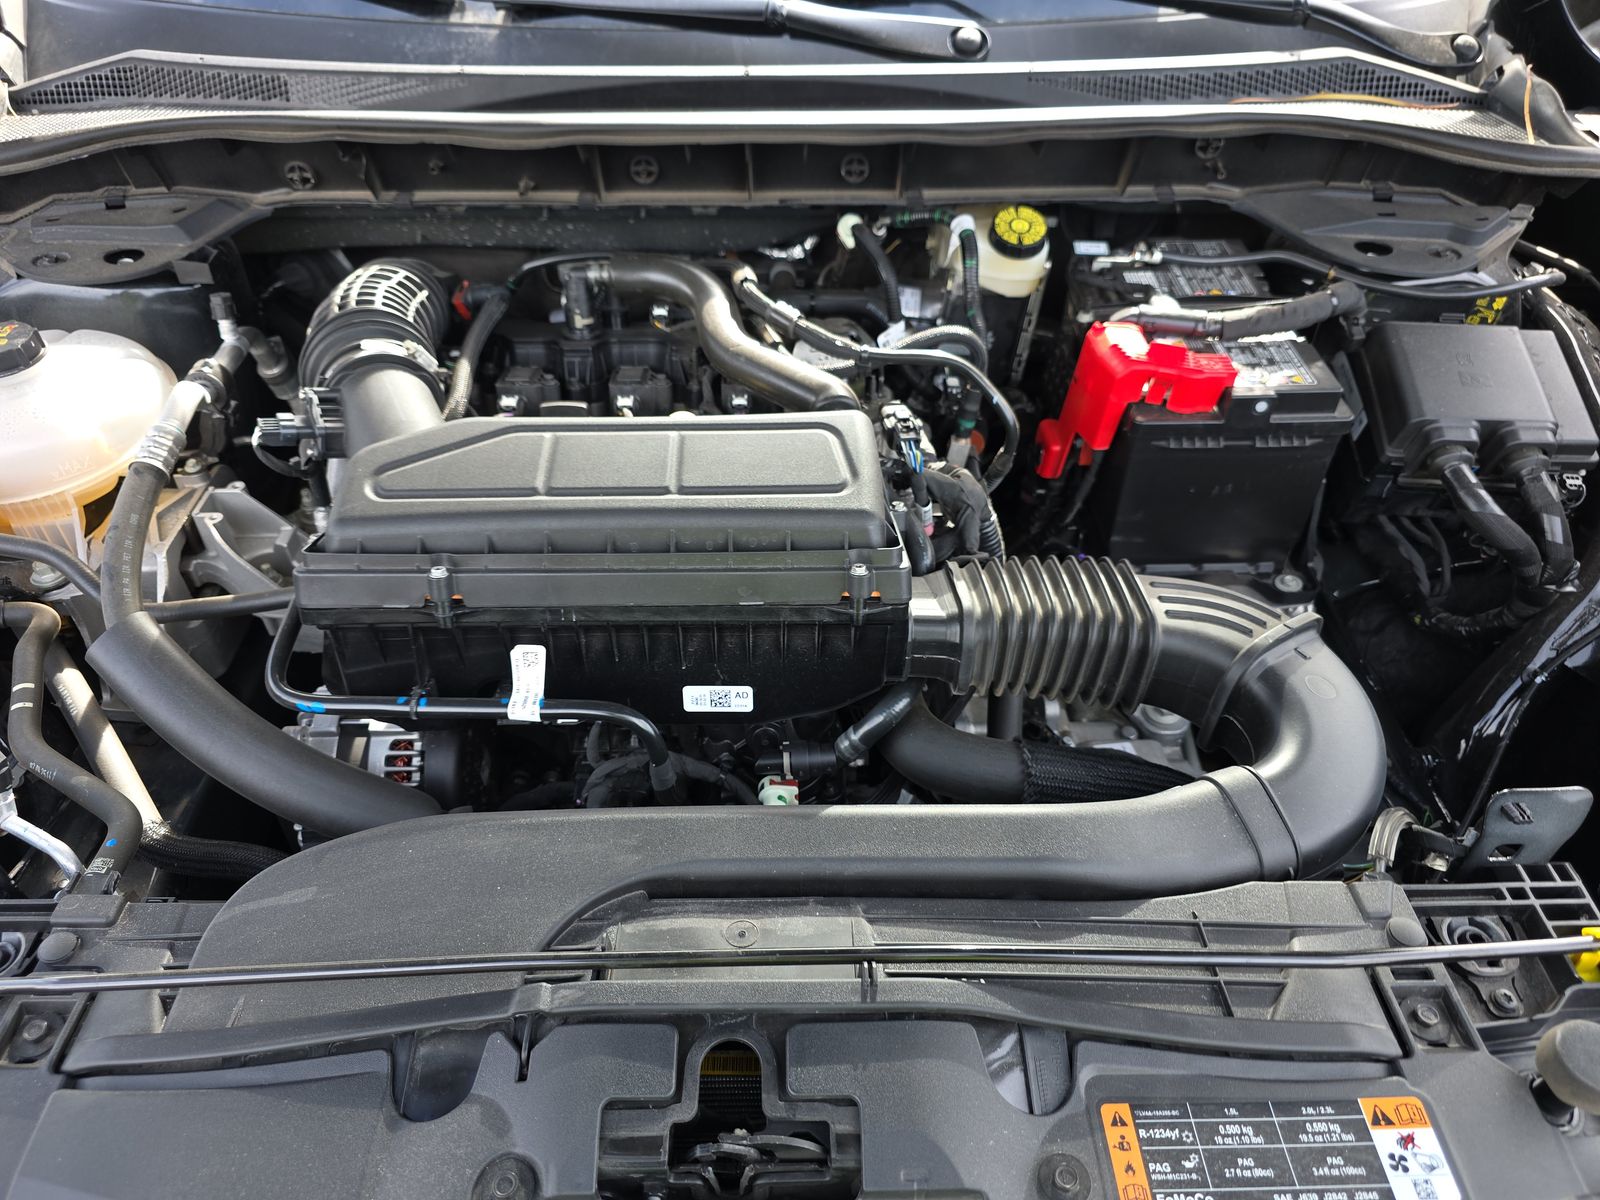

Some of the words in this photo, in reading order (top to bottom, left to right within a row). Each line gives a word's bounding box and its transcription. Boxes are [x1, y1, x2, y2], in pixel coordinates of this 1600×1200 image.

[1219, 1124, 1241, 1135] 0.500
[1241, 1124, 1254, 1136] kg
[1306, 1122, 1328, 1132] 0.550
[1328, 1121, 1341, 1134] kg
[1138, 1128, 1180, 1140] R-1234yf
[1237, 1157, 1255, 1167] PAG
[1326, 1156, 1344, 1165] PAG
[1148, 1162, 1171, 1173] PAG
[1225, 1168, 1235, 1178] 2.7
[1242, 1169, 1252, 1177] oz
